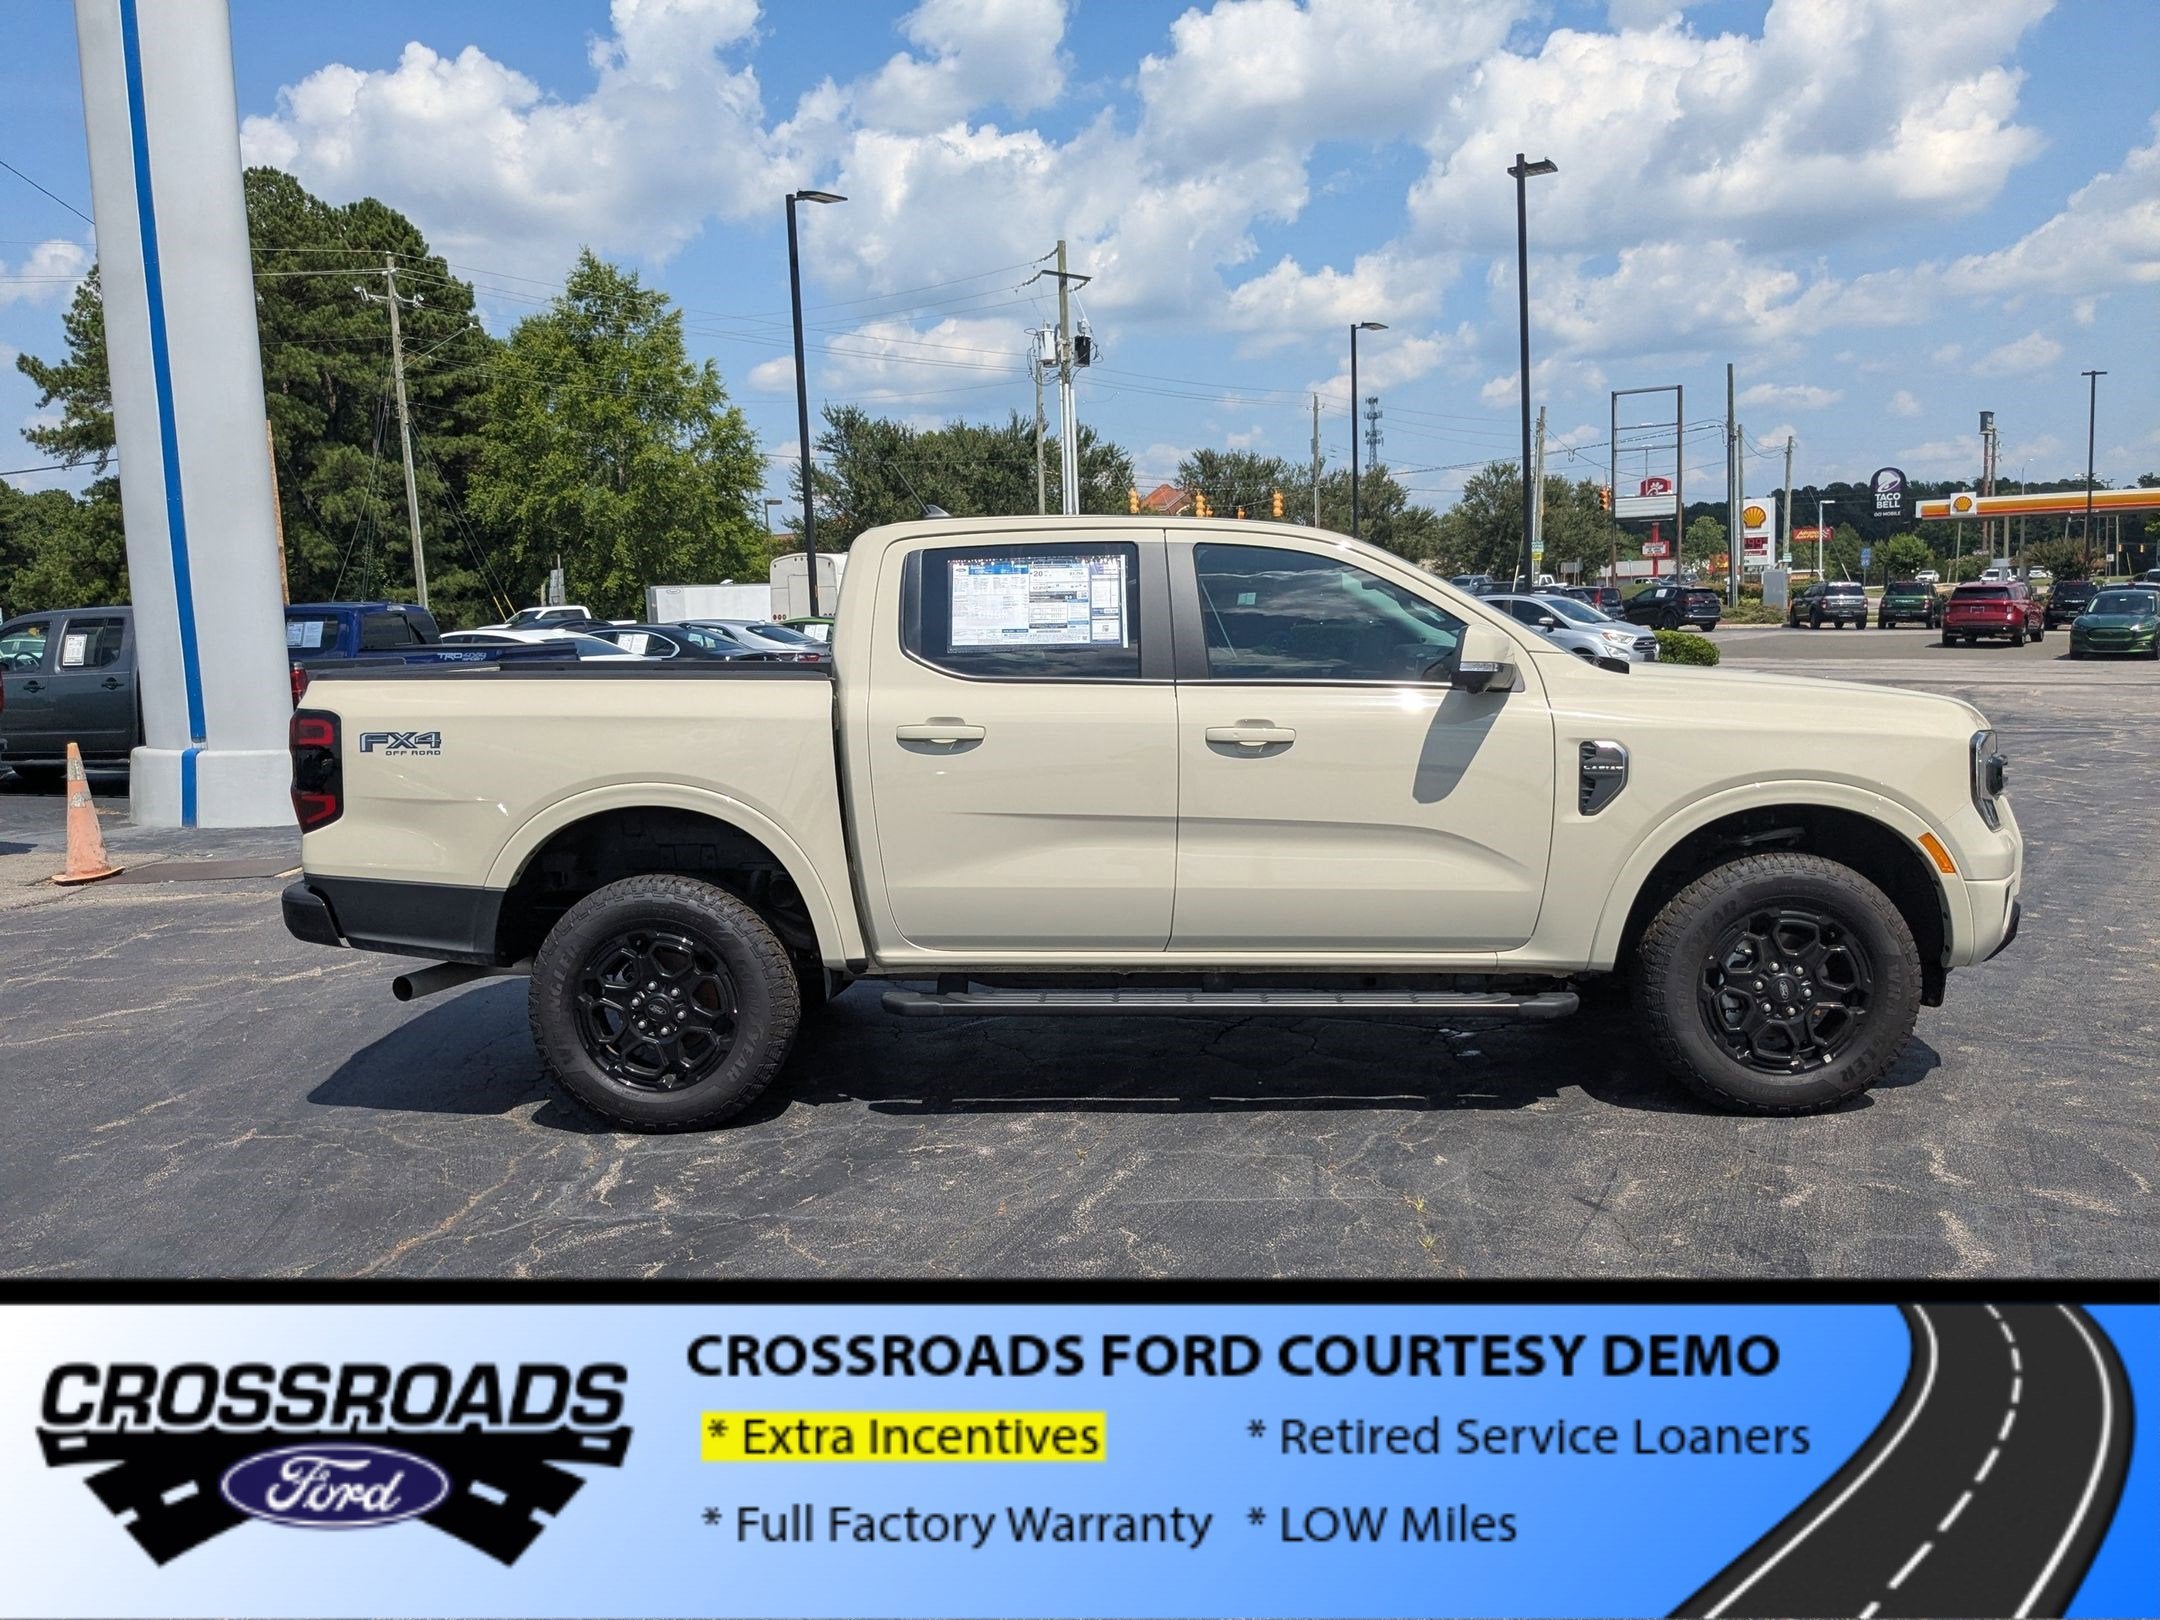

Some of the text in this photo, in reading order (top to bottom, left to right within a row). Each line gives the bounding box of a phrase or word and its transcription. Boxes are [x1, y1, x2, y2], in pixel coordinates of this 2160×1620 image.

[1874, 493, 1901, 501] TACO
[1876, 501, 1901, 509] BELL
[437, 652, 462, 661] TRD
[360, 732, 441, 752] FX4
